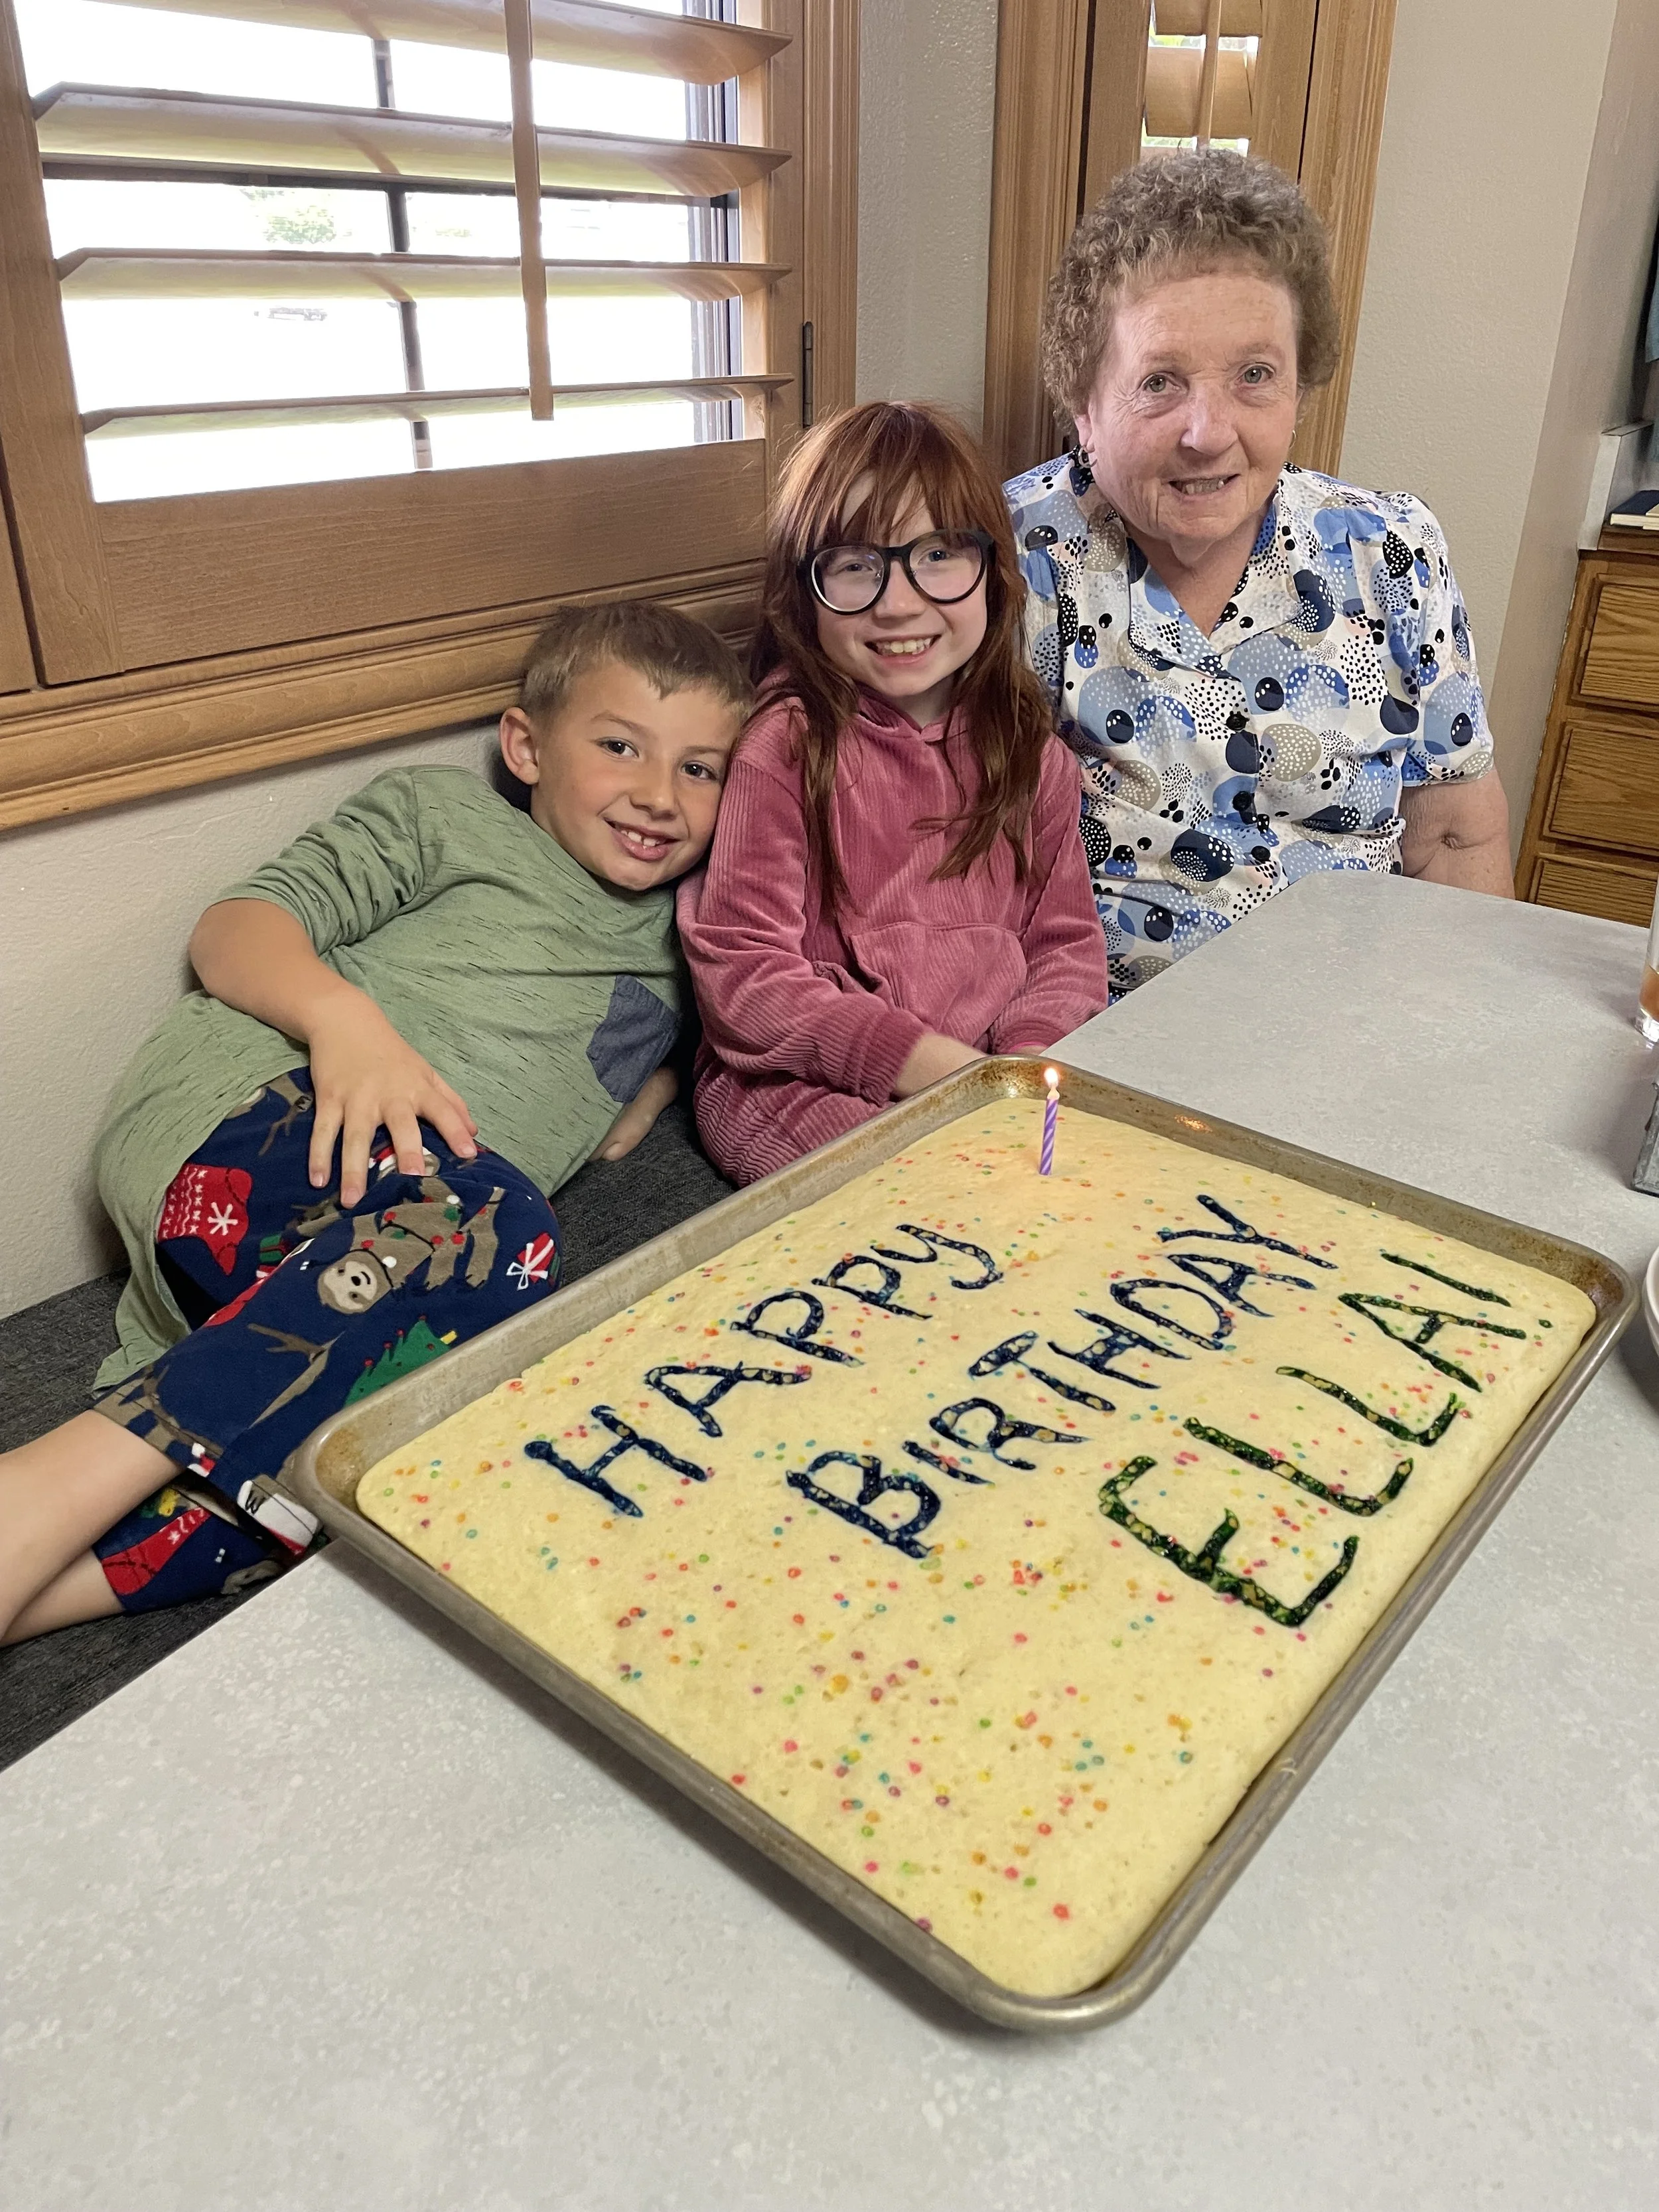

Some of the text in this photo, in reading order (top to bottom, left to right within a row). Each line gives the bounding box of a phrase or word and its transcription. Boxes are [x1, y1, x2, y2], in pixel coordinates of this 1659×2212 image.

[524, 1223, 1004, 1518] HAPPY
[786, 1194, 1339, 1559] BIRTHDAY
[1098, 1252, 1553, 1627] ELLA!
